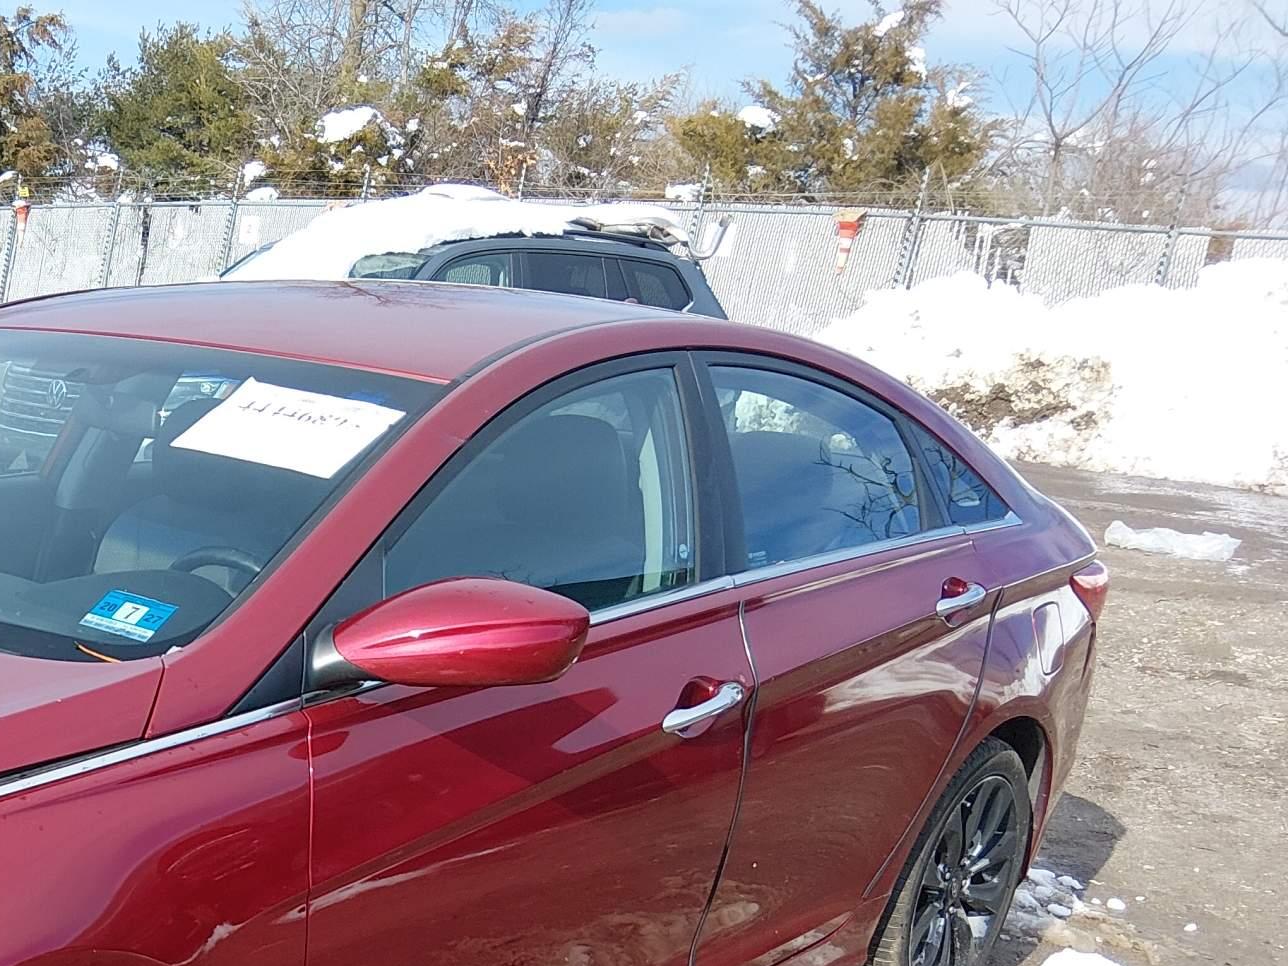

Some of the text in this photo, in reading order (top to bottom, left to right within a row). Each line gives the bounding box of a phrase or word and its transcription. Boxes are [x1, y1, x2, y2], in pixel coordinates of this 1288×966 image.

[99, 601, 163, 624] 20 7 27
